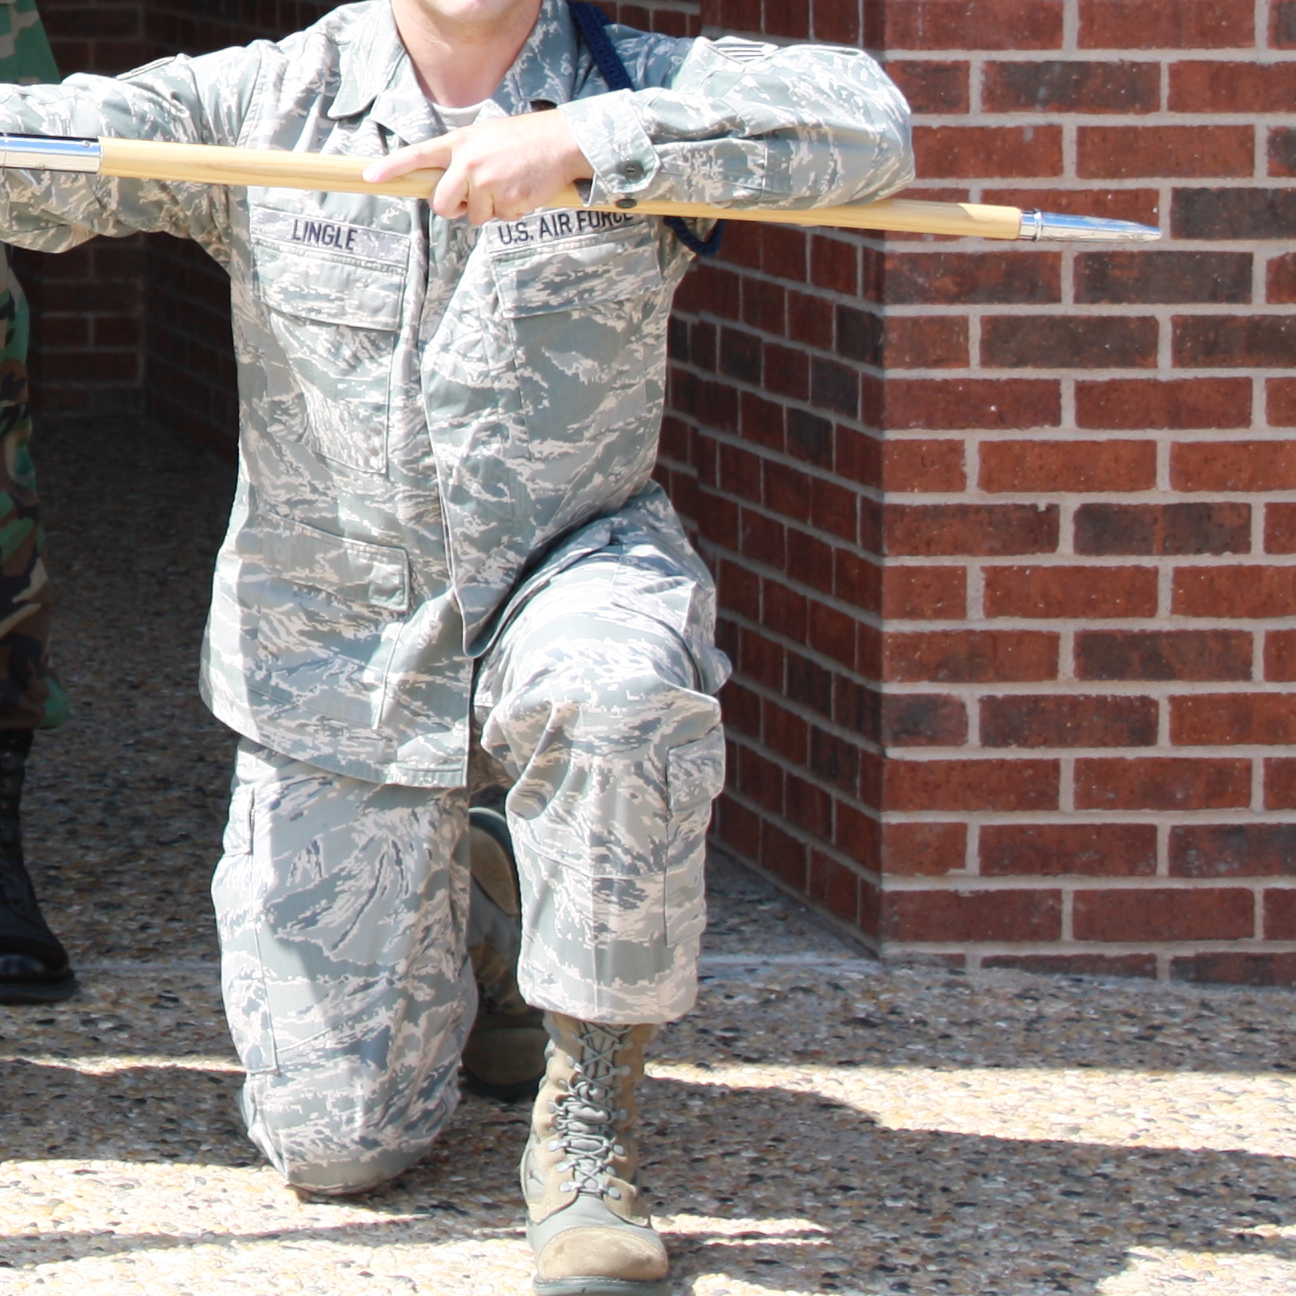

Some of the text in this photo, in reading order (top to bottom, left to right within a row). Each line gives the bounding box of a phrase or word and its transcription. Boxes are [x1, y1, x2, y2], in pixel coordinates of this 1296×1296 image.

[291, 218, 359, 252] LINGLE
[497, 222, 534, 246] U.S.
[539, 212, 573, 239] AIR
